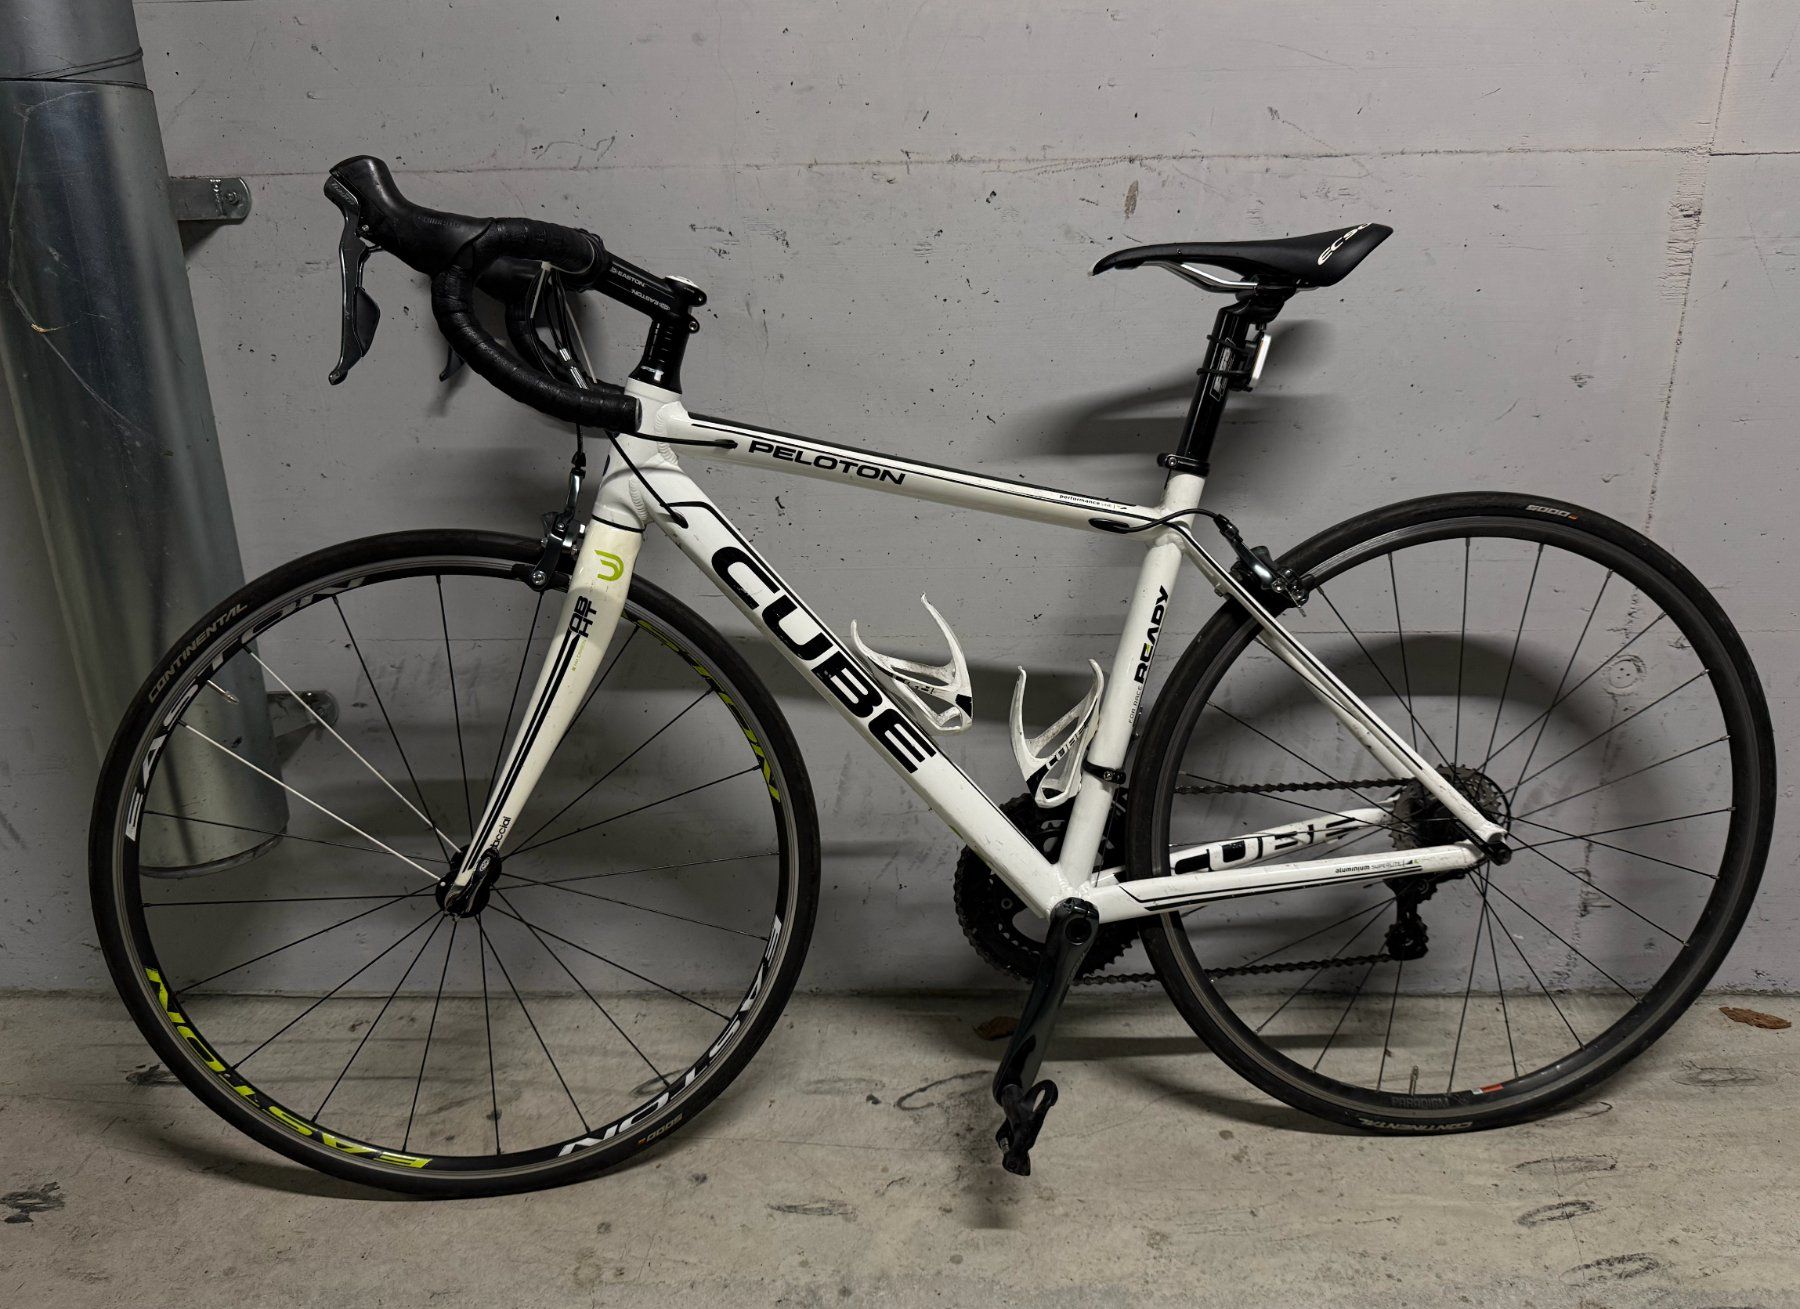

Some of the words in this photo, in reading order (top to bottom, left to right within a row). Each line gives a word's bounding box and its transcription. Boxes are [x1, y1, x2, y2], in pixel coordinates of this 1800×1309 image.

[617, 270, 646, 288] EASTON
[630, 288, 659, 306] EASTON
[748, 438, 906, 485] PELOTON
[148, 602, 248, 704] CONTINENTAL
[711, 546, 936, 774] CUBE
[1134, 585, 1169, 684] READY
[125, 576, 366, 842] EASTON
[1128, 706, 1137, 724] FOR
[1134, 685, 1143, 706] RACE
[144, 967, 432, 1169] EASTON
[558, 914, 782, 1157] EASTON
[1358, 1117, 1474, 1131] CONTINENTAL
